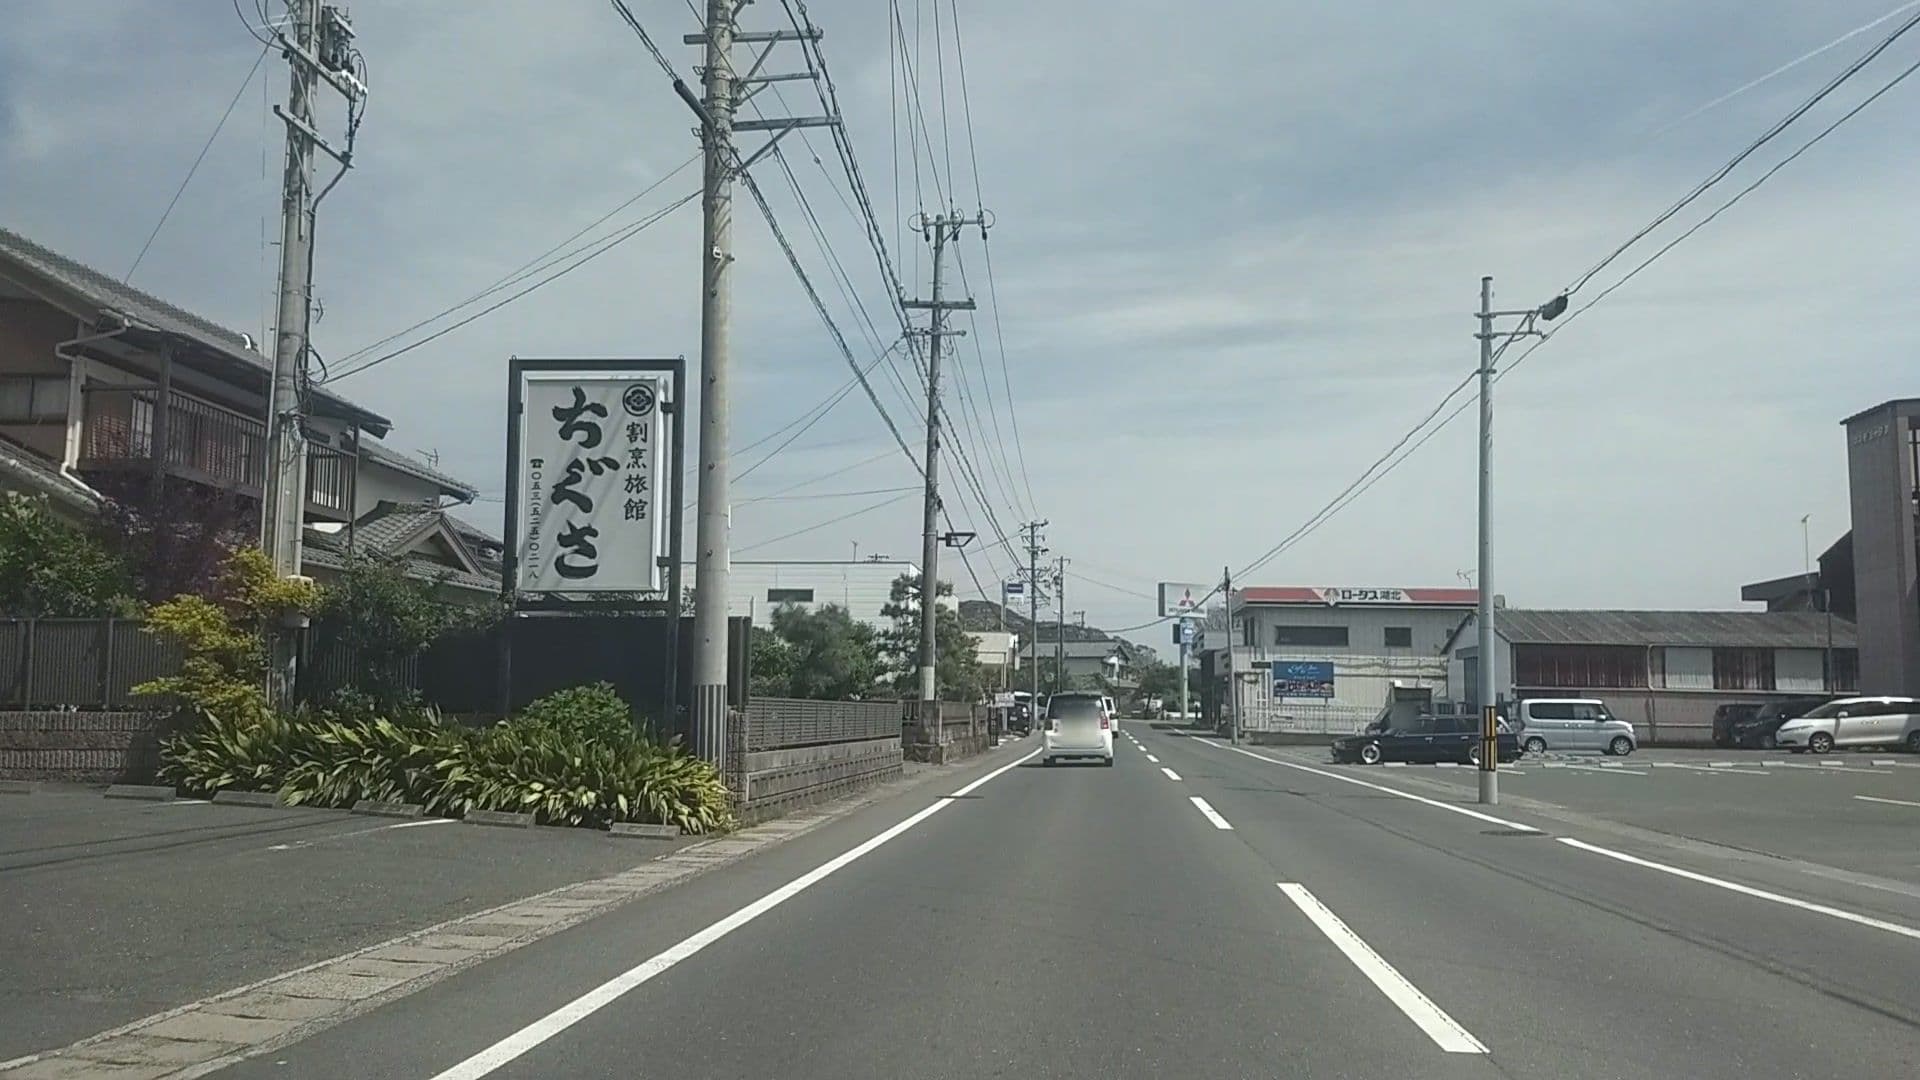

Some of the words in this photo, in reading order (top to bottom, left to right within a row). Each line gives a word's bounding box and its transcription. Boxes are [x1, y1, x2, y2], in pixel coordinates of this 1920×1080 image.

[550, 385, 621, 580] ちぐさ
[623, 421, 649, 521] 割烹旅館
